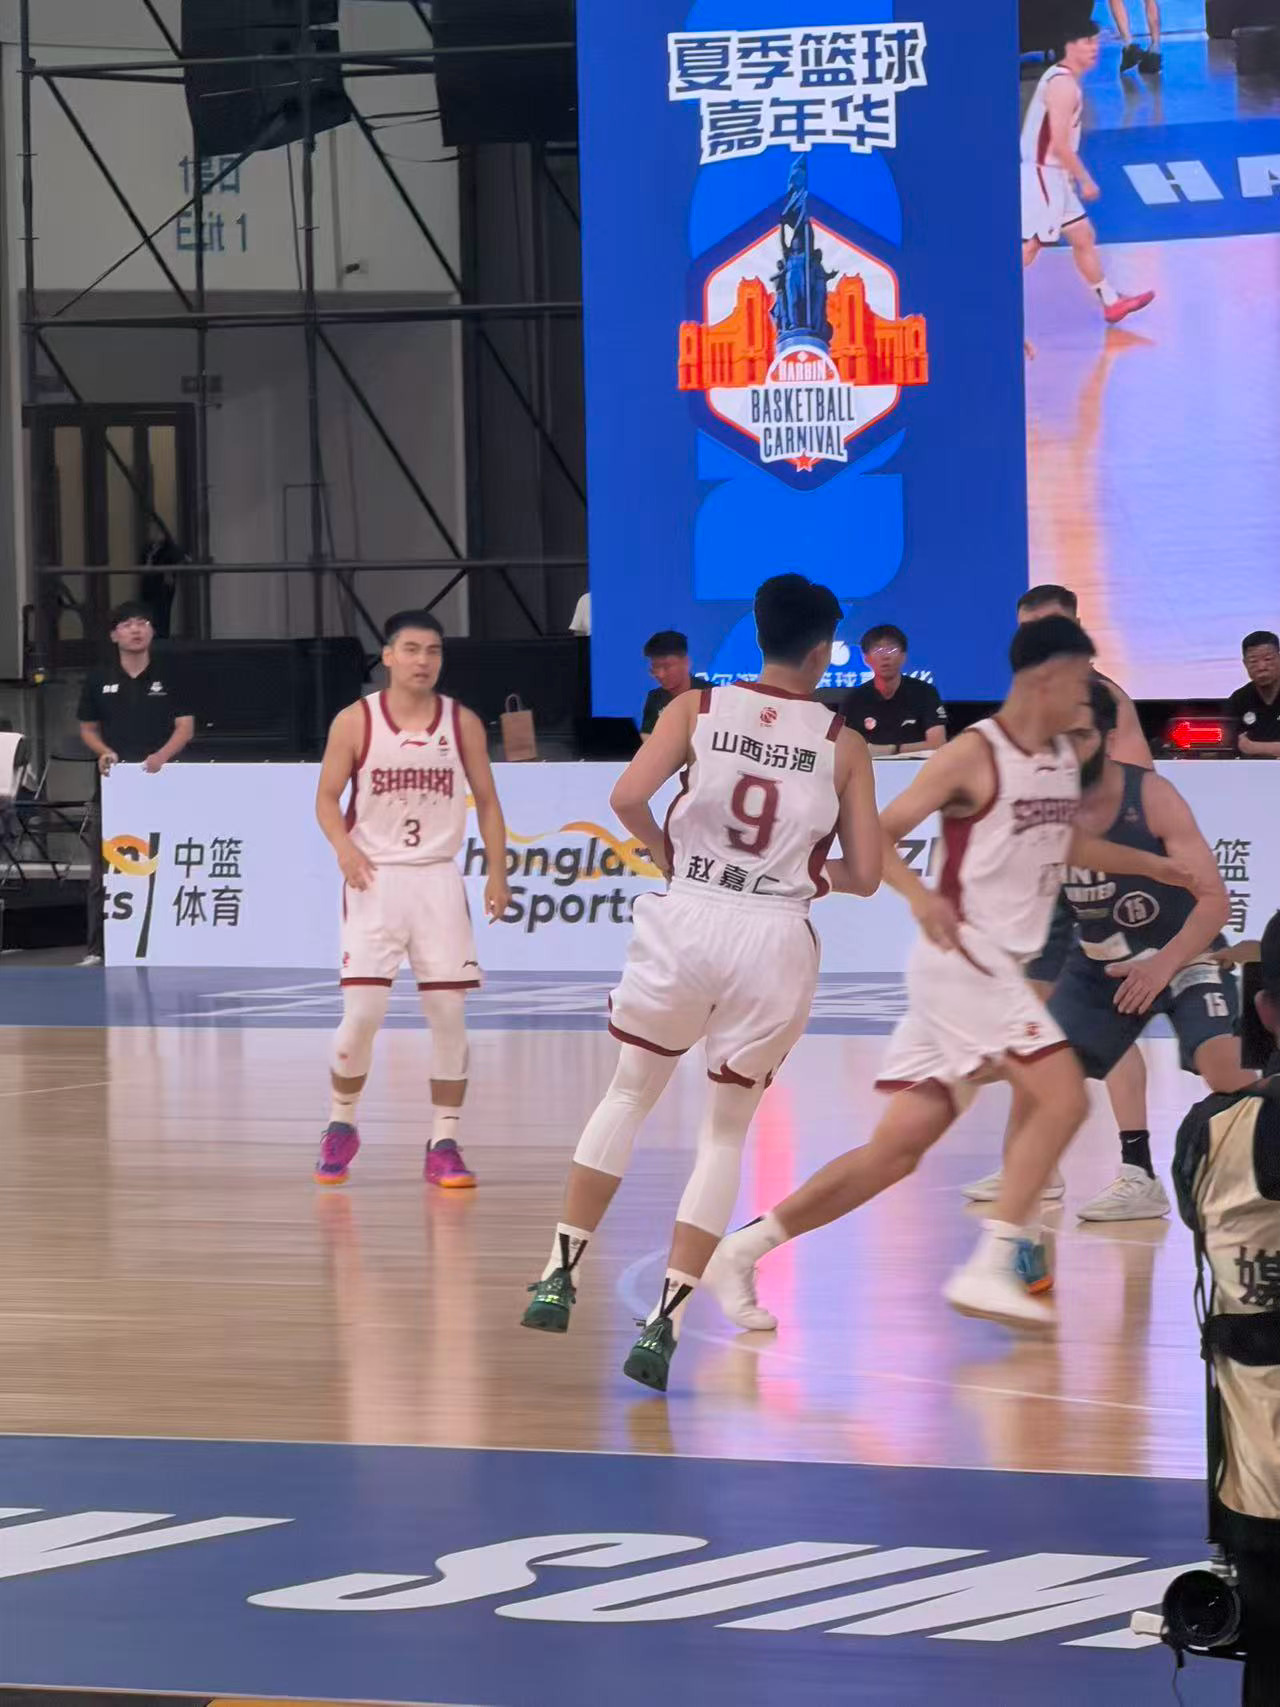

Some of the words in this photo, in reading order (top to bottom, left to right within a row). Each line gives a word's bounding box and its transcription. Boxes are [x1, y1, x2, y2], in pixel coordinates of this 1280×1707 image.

[674, 29, 919, 93] 夏季篮球
[707, 94, 889, 157] 嘉年华
[751, 387, 855, 423] BASKETBALL
[763, 426, 845, 458] CARNIVAL
[711, 731, 817, 773] 山西汾酒
[371, 768, 454, 799] SHANXI
[404, 819, 421, 847] 3
[728, 773, 780, 859] 9
[174, 837, 243, 879] 中篮
[172, 885, 243, 927] 体育
[1123, 896, 1148, 924] 15
